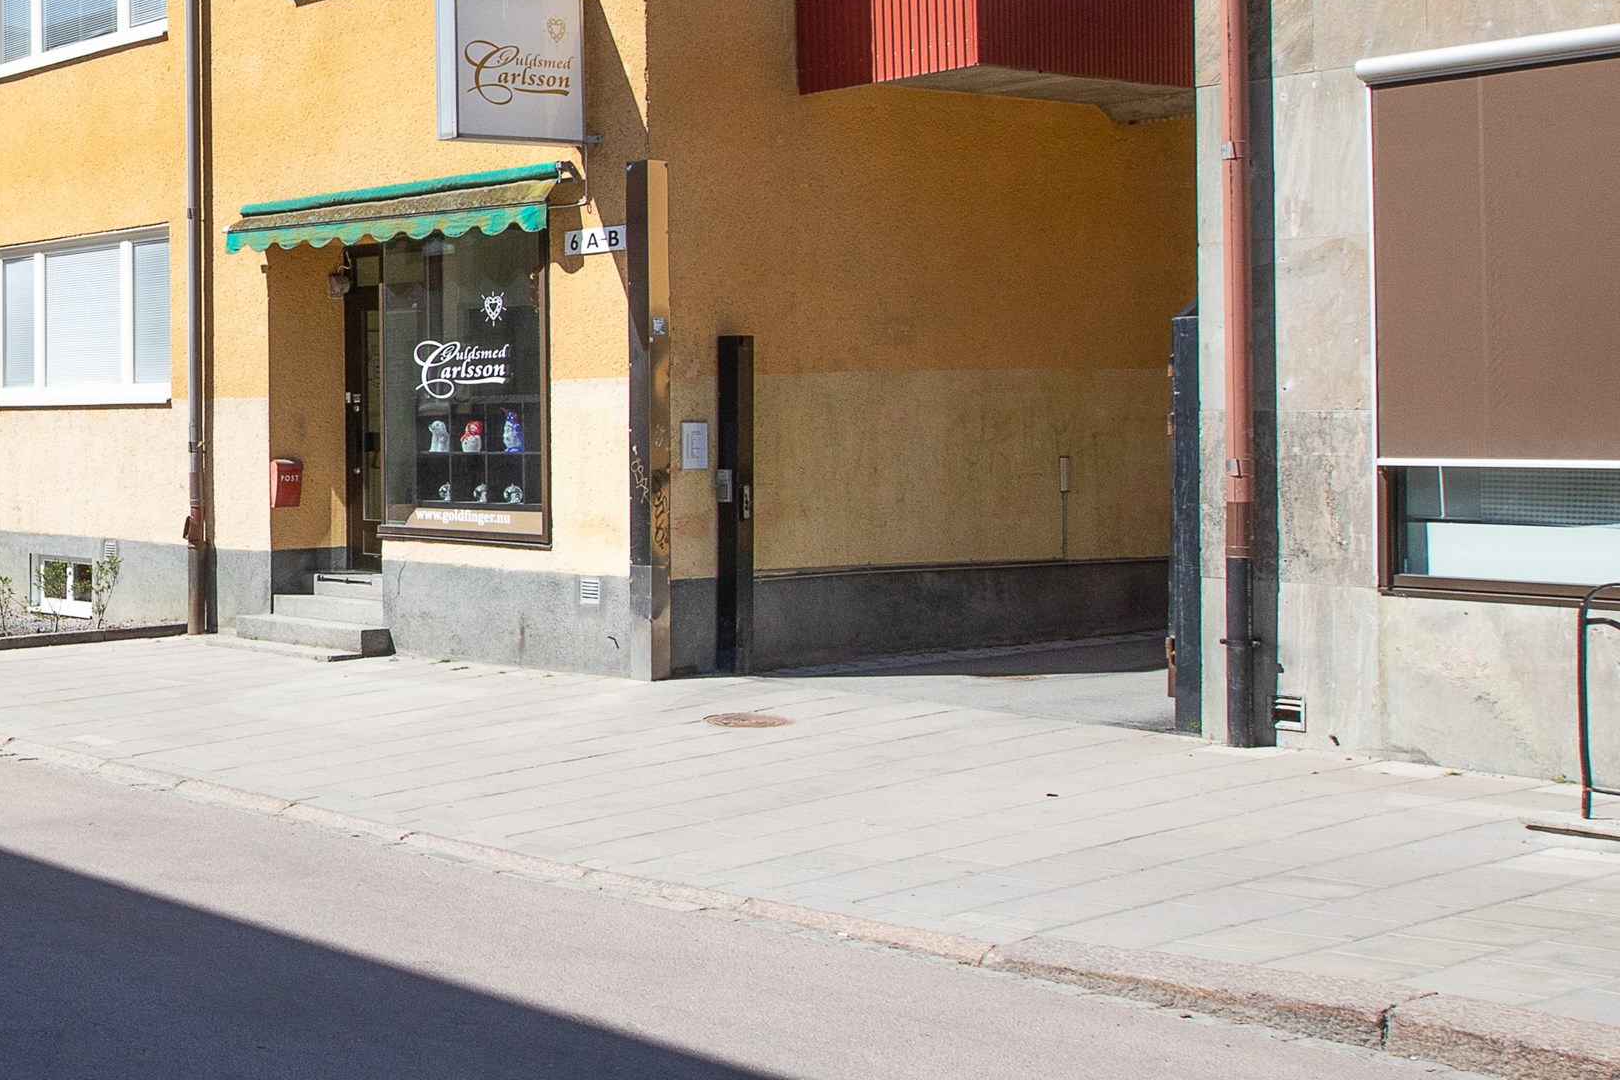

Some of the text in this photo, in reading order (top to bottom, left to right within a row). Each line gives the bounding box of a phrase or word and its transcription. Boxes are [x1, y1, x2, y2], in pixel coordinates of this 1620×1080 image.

[496, 50, 574, 70] Guldsmed
[464, 40, 570, 105] Carlsson
[570, 230, 620, 251] 6 A-B
[440, 344, 510, 361] Guldsmed
[413, 340, 506, 399] Carlsson
[280, 474, 299, 482] POST
[415, 509, 511, 526] www.goldfinger.nu
